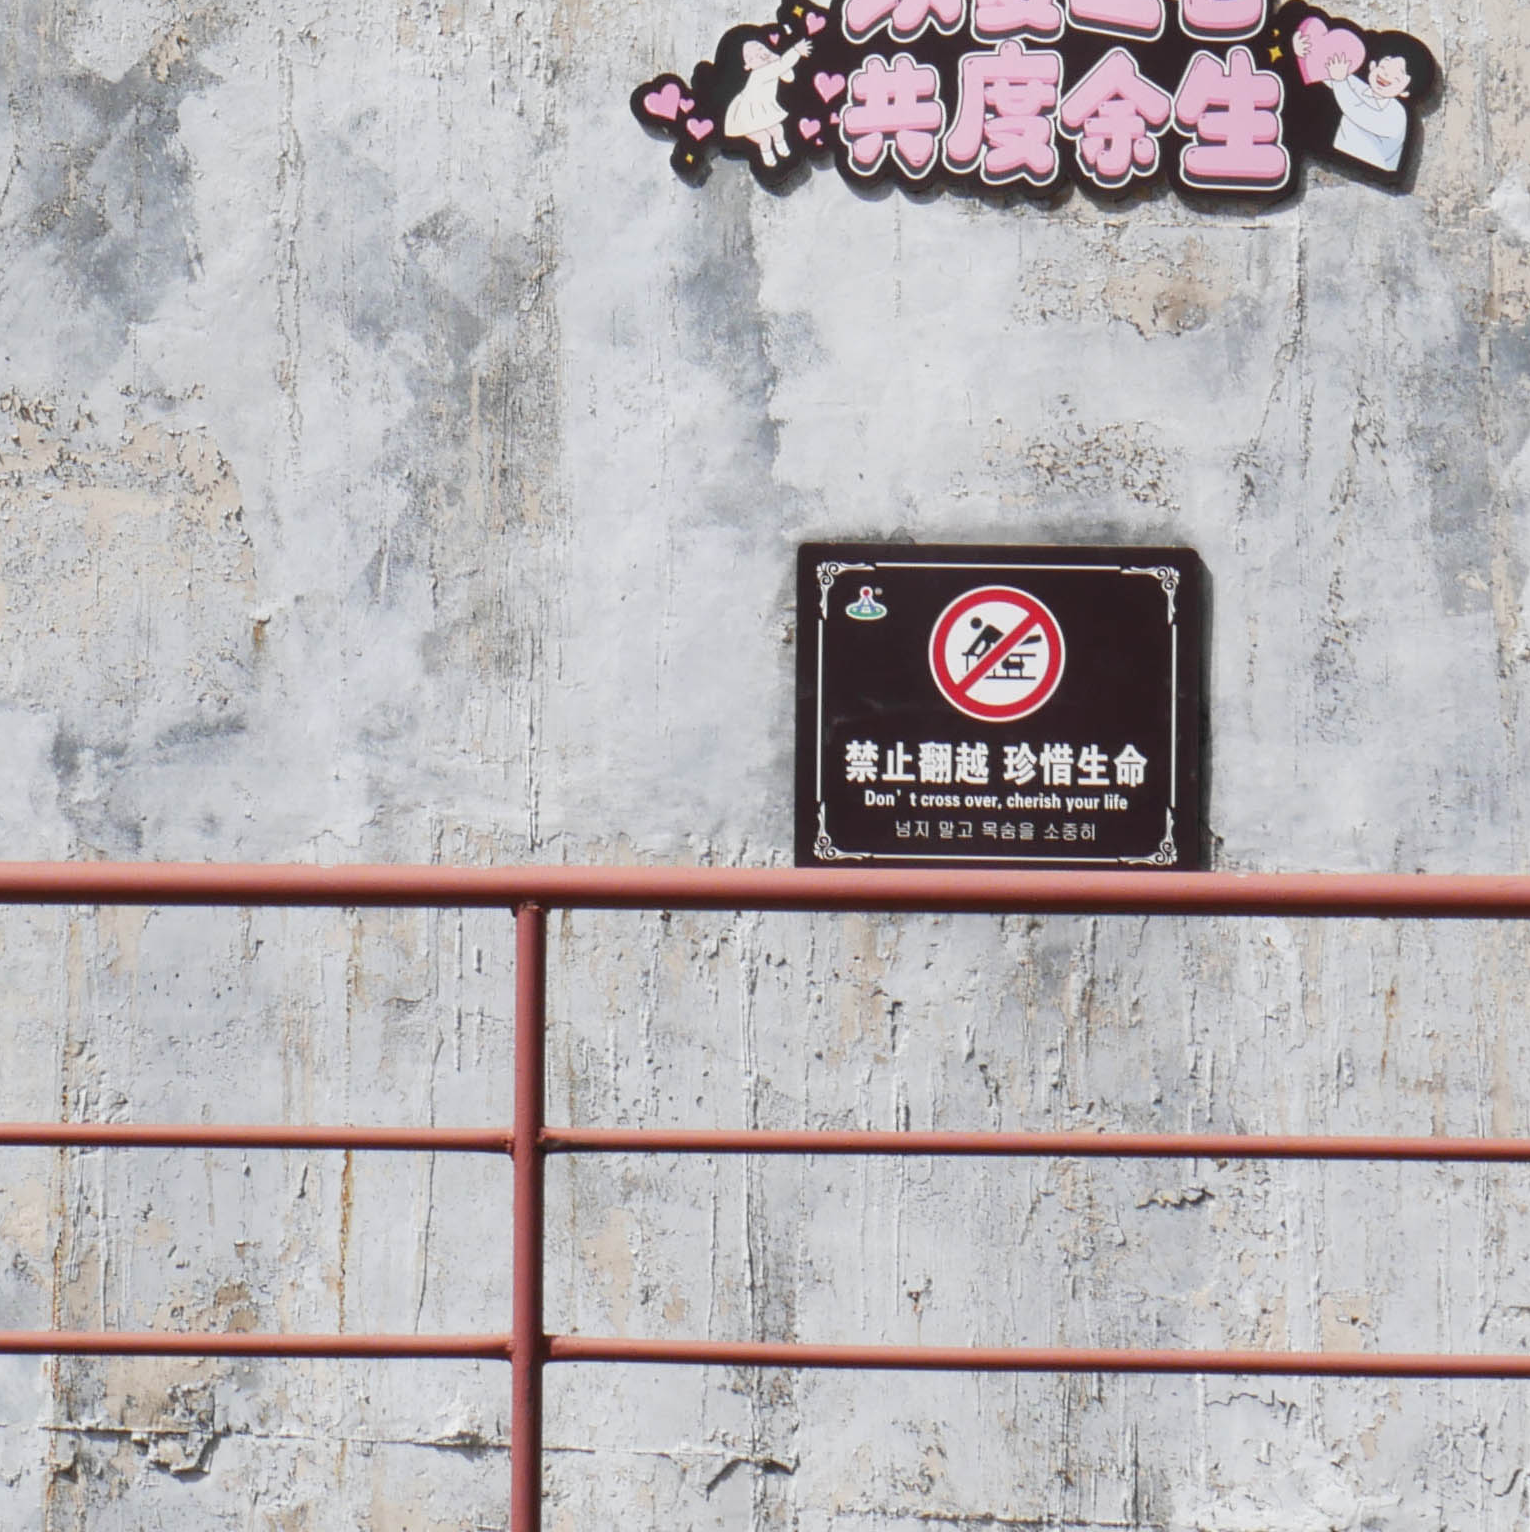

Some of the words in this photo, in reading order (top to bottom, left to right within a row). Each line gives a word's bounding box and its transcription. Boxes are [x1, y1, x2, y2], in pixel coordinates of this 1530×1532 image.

[839, 40, 1291, 191] 共度余生
[845, 740, 989, 784] 禁止翻越
[1004, 743, 1147, 787] 珍惜生命
[921, 795, 960, 807] cross
[965, 796, 1002, 809] over,
[1007, 793, 1061, 808] cherish
[1066, 798, 1099, 812] your
[1104, 794, 1127, 809] life
[896, 821, 928, 837] 넘지
[939, 821, 972, 838] 말고
[983, 822, 1033, 839] 목숨을
[1045, 824, 1095, 840] 소중히
